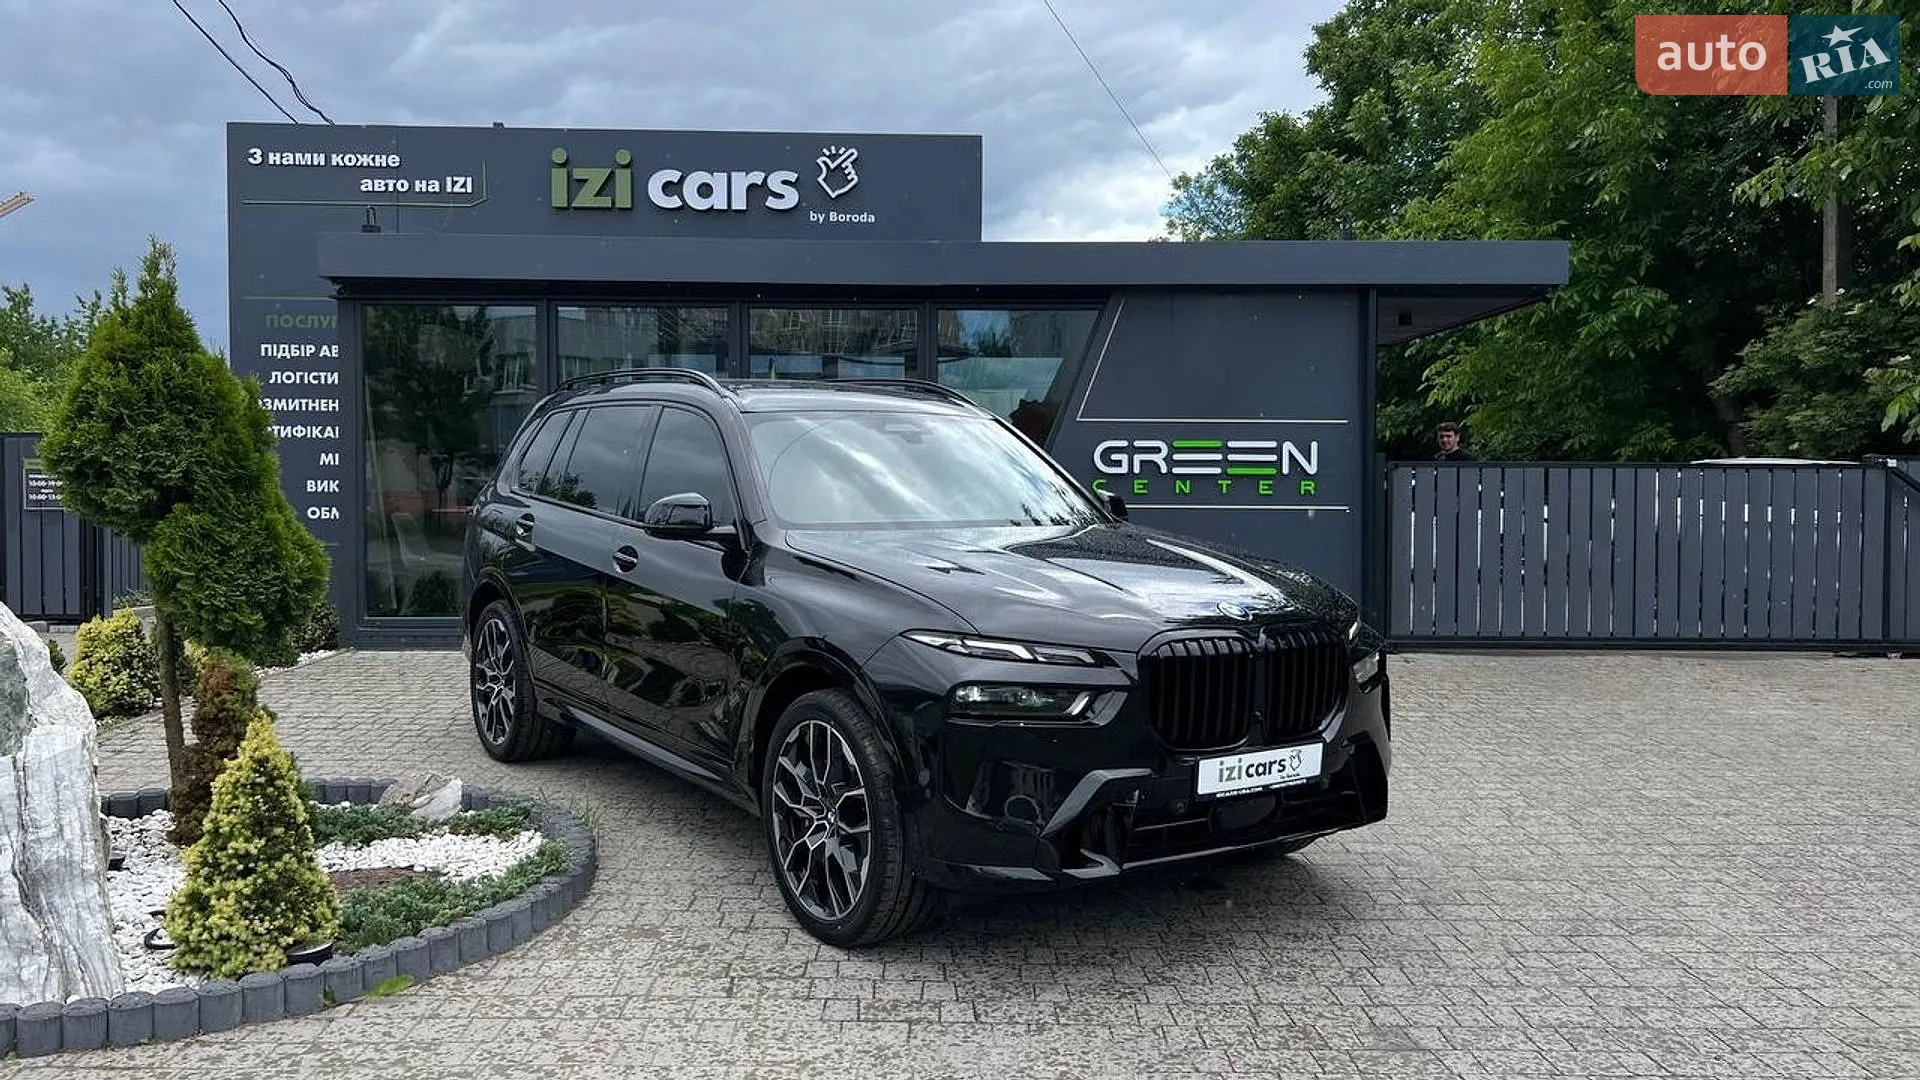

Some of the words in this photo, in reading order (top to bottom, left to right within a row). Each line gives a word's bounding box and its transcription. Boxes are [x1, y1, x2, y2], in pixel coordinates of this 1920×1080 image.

[267, 152, 327, 167] нами
[331, 153, 401, 168] кожне
[359, 177, 410, 193] авто
[414, 177, 441, 193] на
[445, 176, 473, 194] IZI
[551, 147, 633, 209] izi
[647, 167, 799, 211] cars
[809, 212, 825, 225] by
[828, 211, 876, 223] Boroda
[260, 343, 316, 359] ПІДБІР
[269, 371, 340, 385] ЛОГІСТИ
[1093, 439, 1319, 476] GREEN
[1091, 479, 1317, 496] CENTER
[1218, 757, 1243, 783] izi
[1245, 758, 1287, 778] cars
